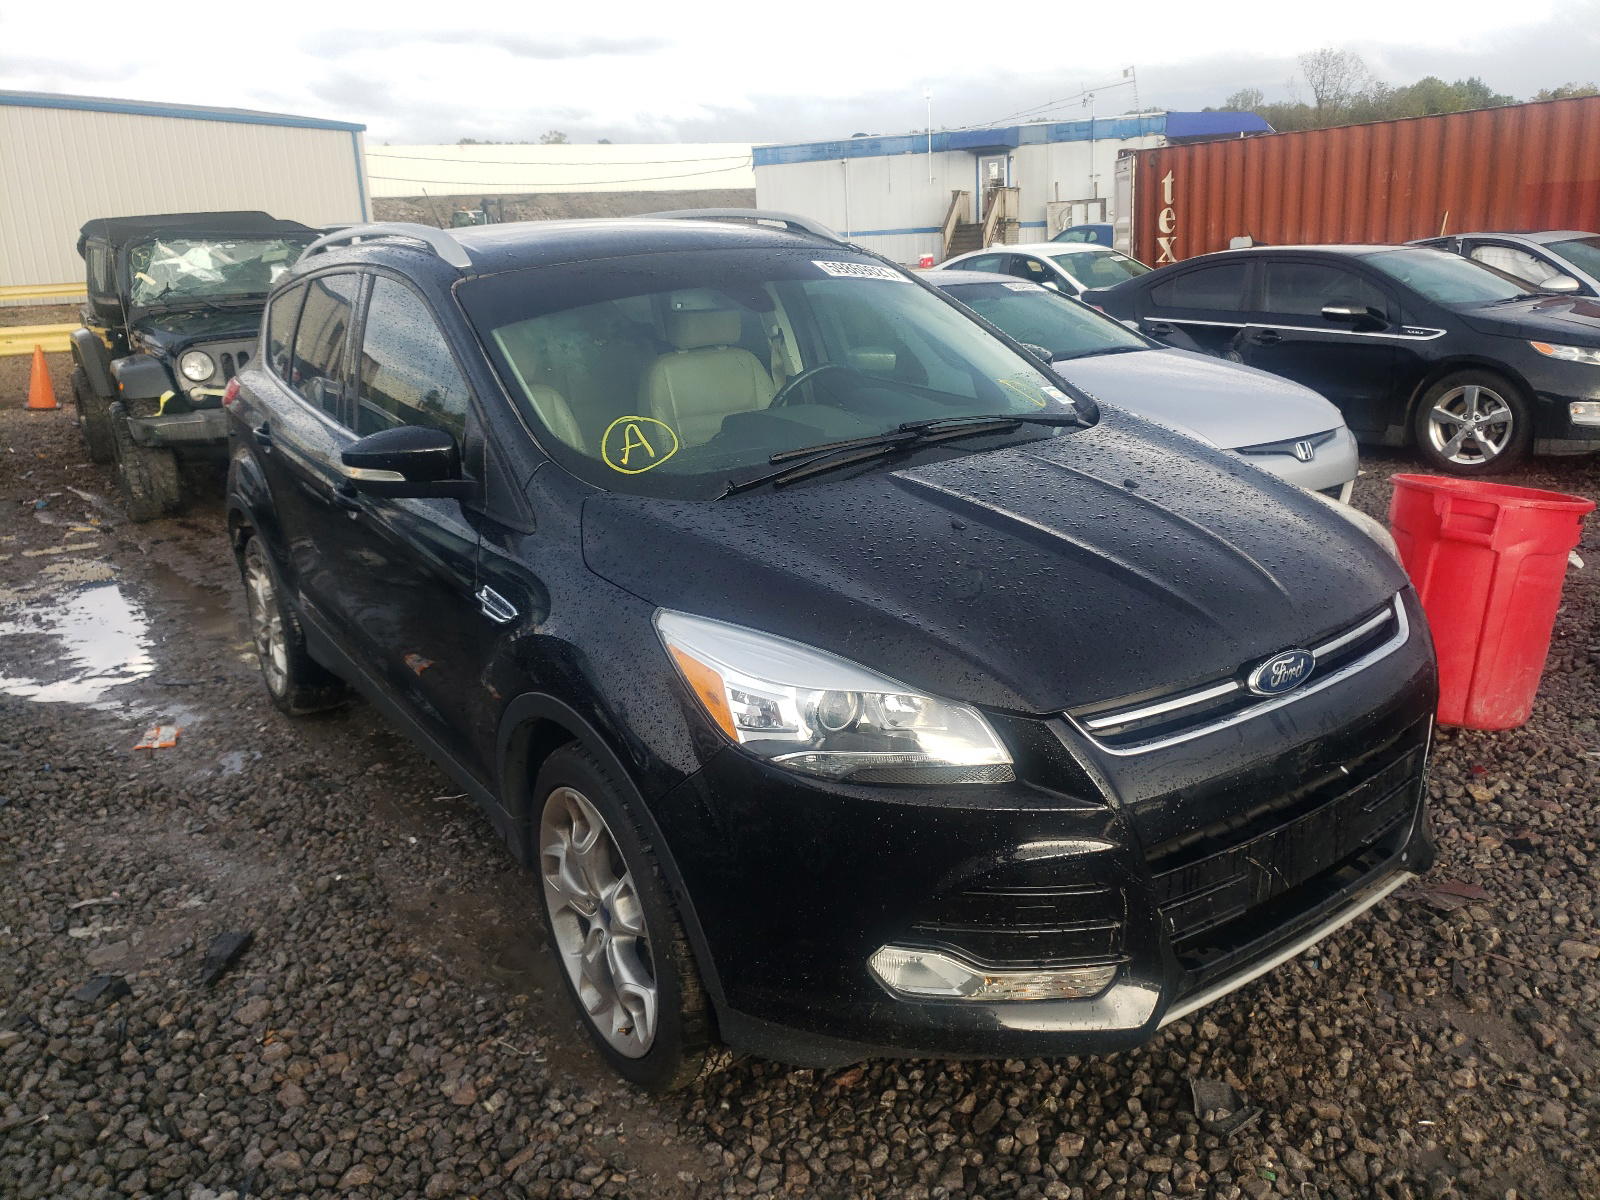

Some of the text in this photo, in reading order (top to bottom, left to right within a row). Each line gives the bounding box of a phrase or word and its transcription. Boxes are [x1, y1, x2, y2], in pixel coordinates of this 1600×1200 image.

[1156, 169, 1178, 263] tex
[619, 423, 655, 465] A
[1270, 655, 1304, 688] Ford
